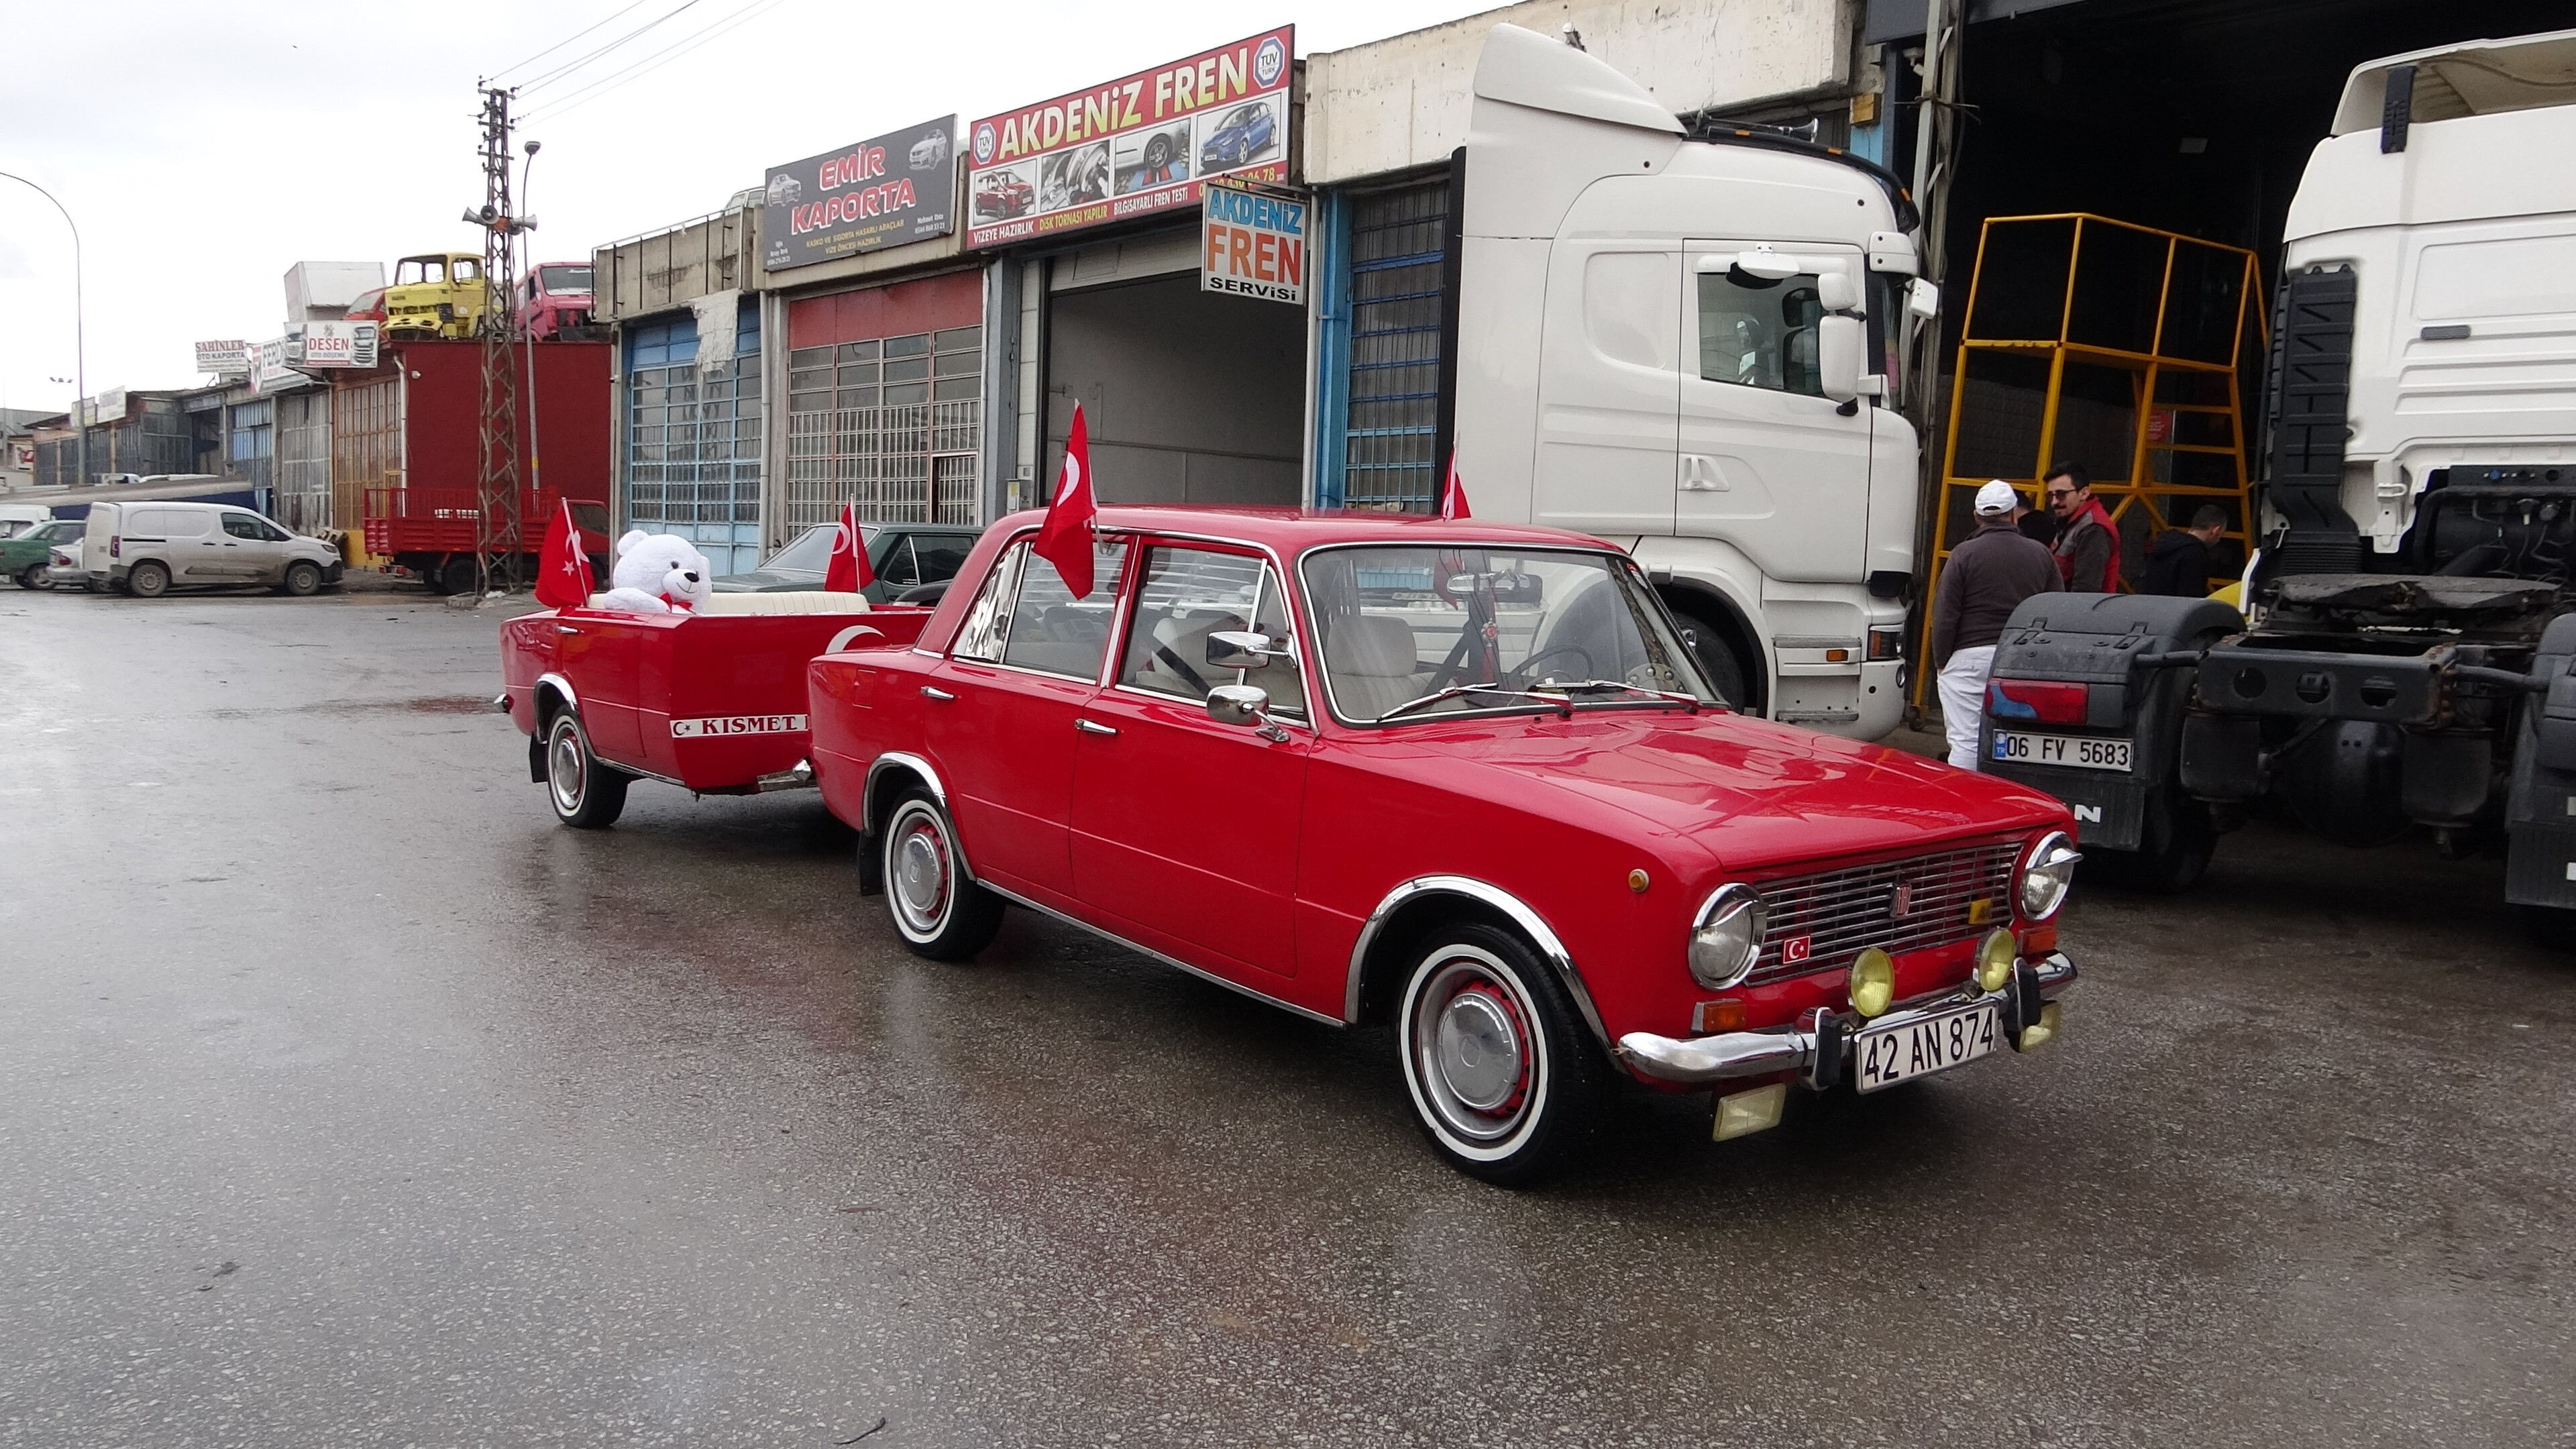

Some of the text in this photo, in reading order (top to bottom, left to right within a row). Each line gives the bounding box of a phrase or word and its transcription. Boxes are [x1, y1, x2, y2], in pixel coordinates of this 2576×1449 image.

[1155, 47, 1248, 119] FREN
[819, 143, 886, 191] EMİR
[1263, 166, 1275, 182] 78
[791, 178, 917, 235] KAPORTA
[1154, 191, 1171, 207] FREN
[1055, 211, 1082, 228] TORNASI
[1083, 205, 1108, 222] YAPILIR
[999, 221, 1034, 239] HAZIRLIK
[1207, 223, 1301, 286] FREN
[309, 337, 349, 350] DESEN
[212, 352, 245, 360] KAPORTA
[702, 716, 798, 735] KISMET
[2006, 736, 2129, 766] 06 FV 5683
[1865, 1008, 1994, 1083] 42 AN 874
